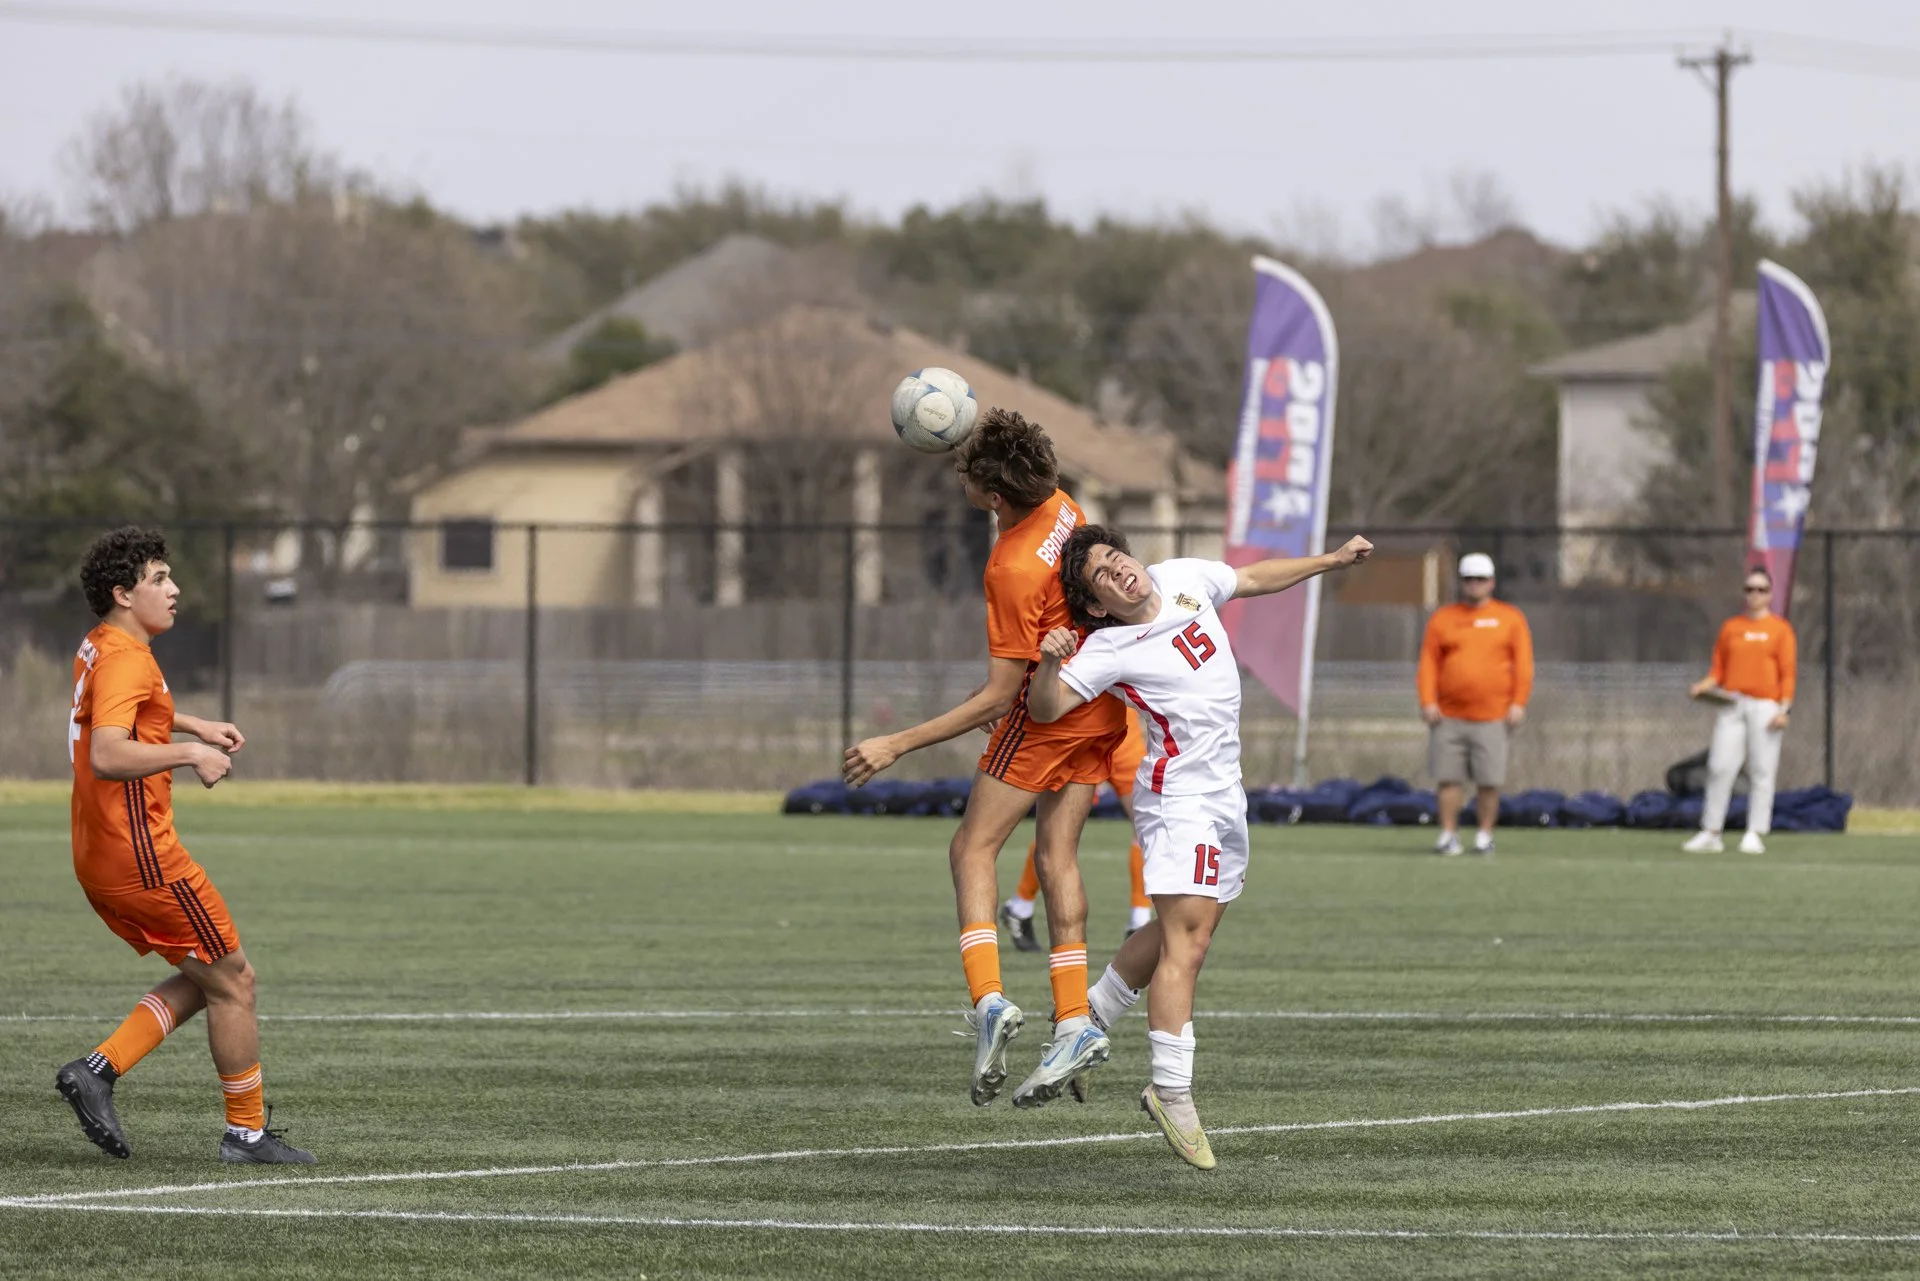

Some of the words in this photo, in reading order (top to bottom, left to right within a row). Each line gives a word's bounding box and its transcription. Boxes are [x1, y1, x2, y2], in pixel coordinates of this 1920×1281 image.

[1036, 518, 1071, 567] BROOK
[1172, 620, 1216, 671] 15
[1194, 843, 1222, 886] 15
